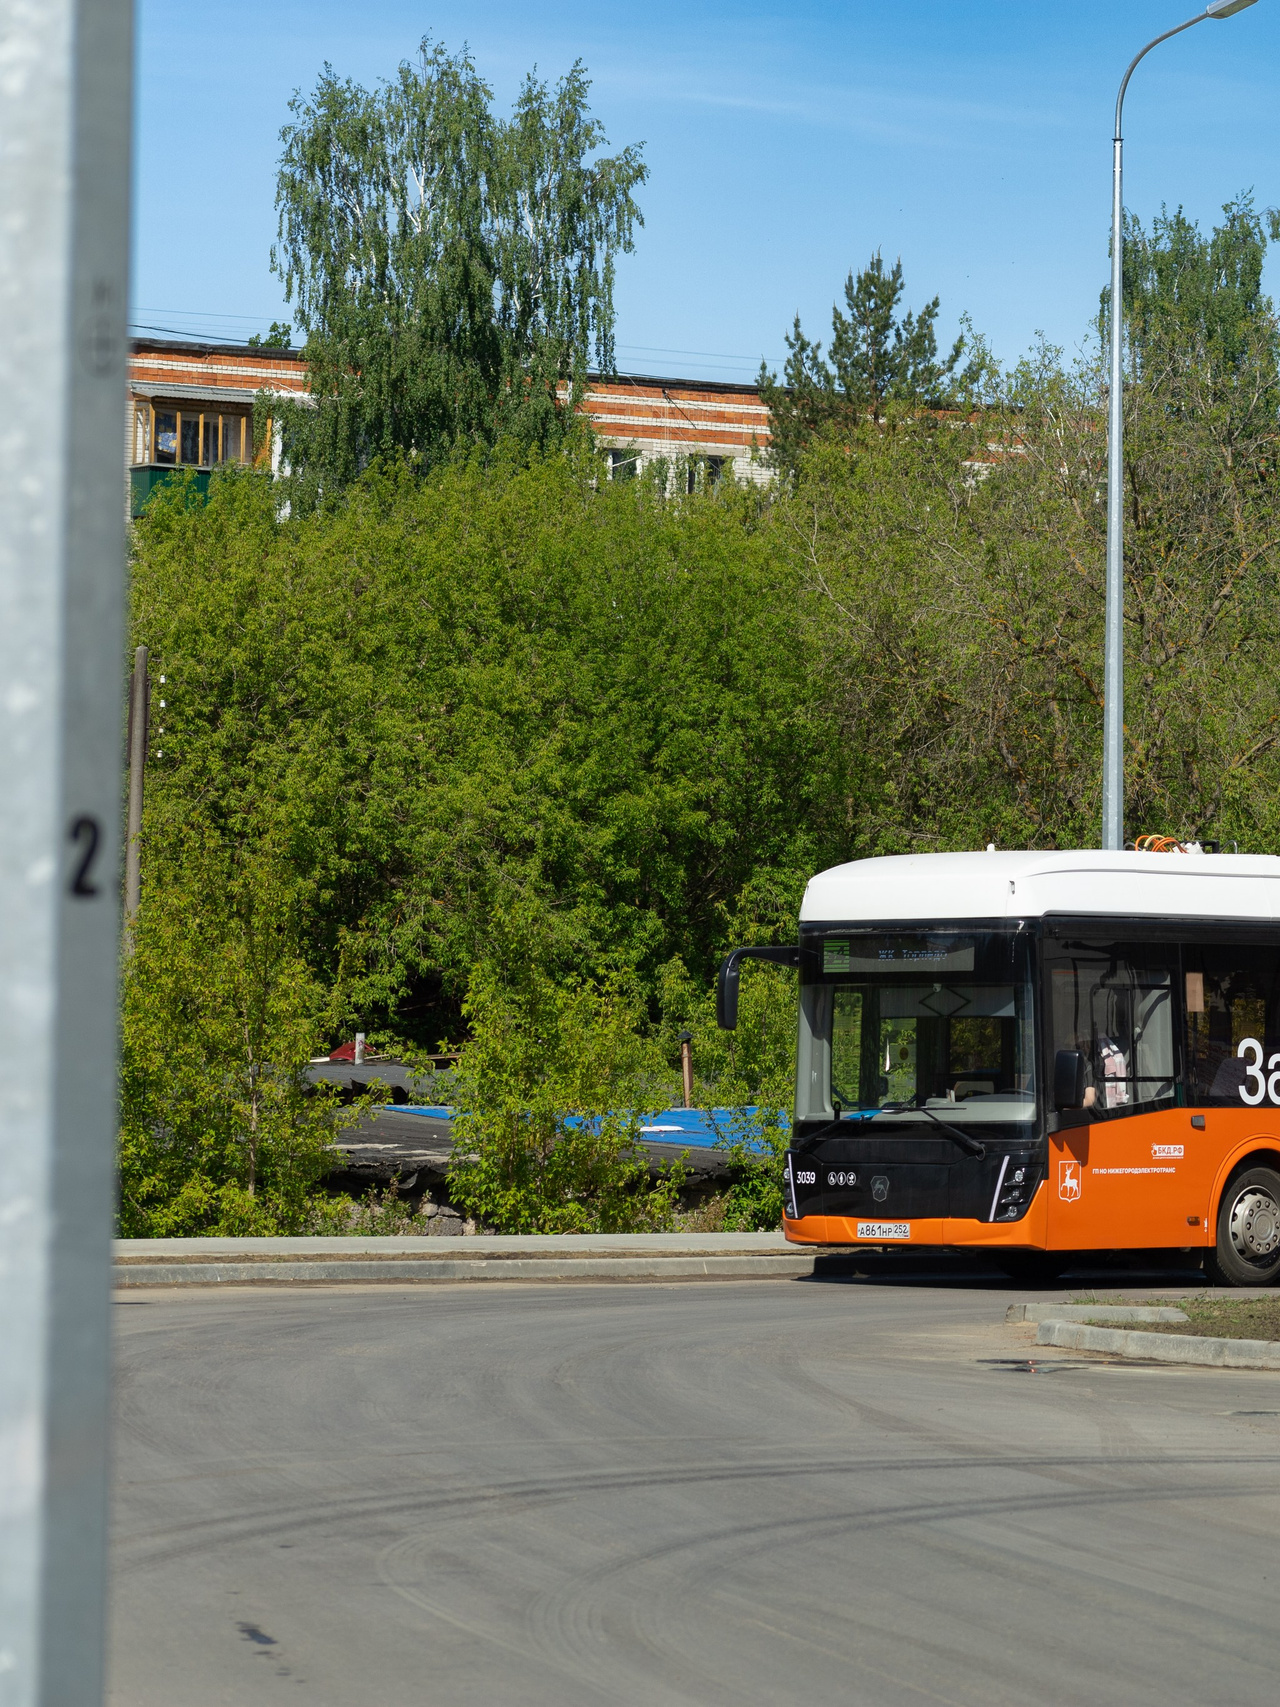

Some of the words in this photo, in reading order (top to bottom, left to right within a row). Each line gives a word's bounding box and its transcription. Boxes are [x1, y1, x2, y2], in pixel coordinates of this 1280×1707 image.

[70, 814, 101, 898] 2
[1158, 1147, 1183, 1155] БКД.РФ
[796, 1171, 816, 1184] 3039
[894, 1224, 909, 1234] 252
